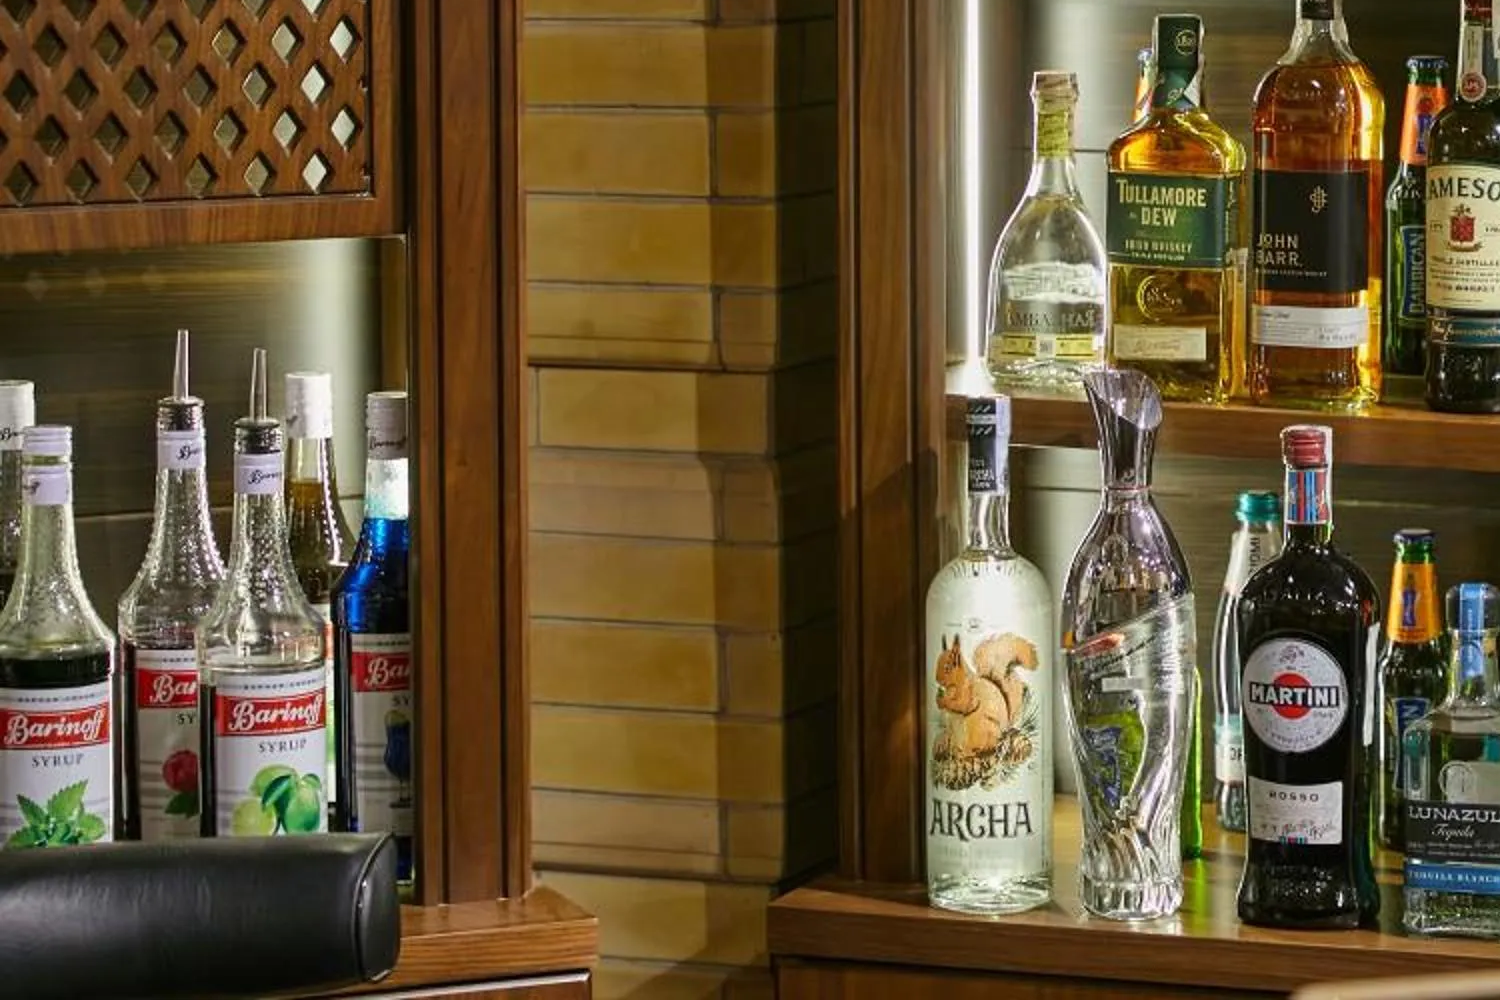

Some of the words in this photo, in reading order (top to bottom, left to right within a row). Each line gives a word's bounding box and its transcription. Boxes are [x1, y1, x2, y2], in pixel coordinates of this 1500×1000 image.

[1116, 179, 1207, 207] TULLAMORE
[1141, 207, 1177, 227] DEW
[1256, 233, 1299, 249] JOHN
[1251, 683, 1338, 707] MARTINI
[229, 697, 322, 732] Barinoff
[4, 711, 105, 745] Barinoff
[258, 738, 308, 754] SYRUP
[31, 752, 86, 768] SYRUP
[1269, 791, 1319, 802] ROSSO
[930, 798, 1033, 842] ARCHA
